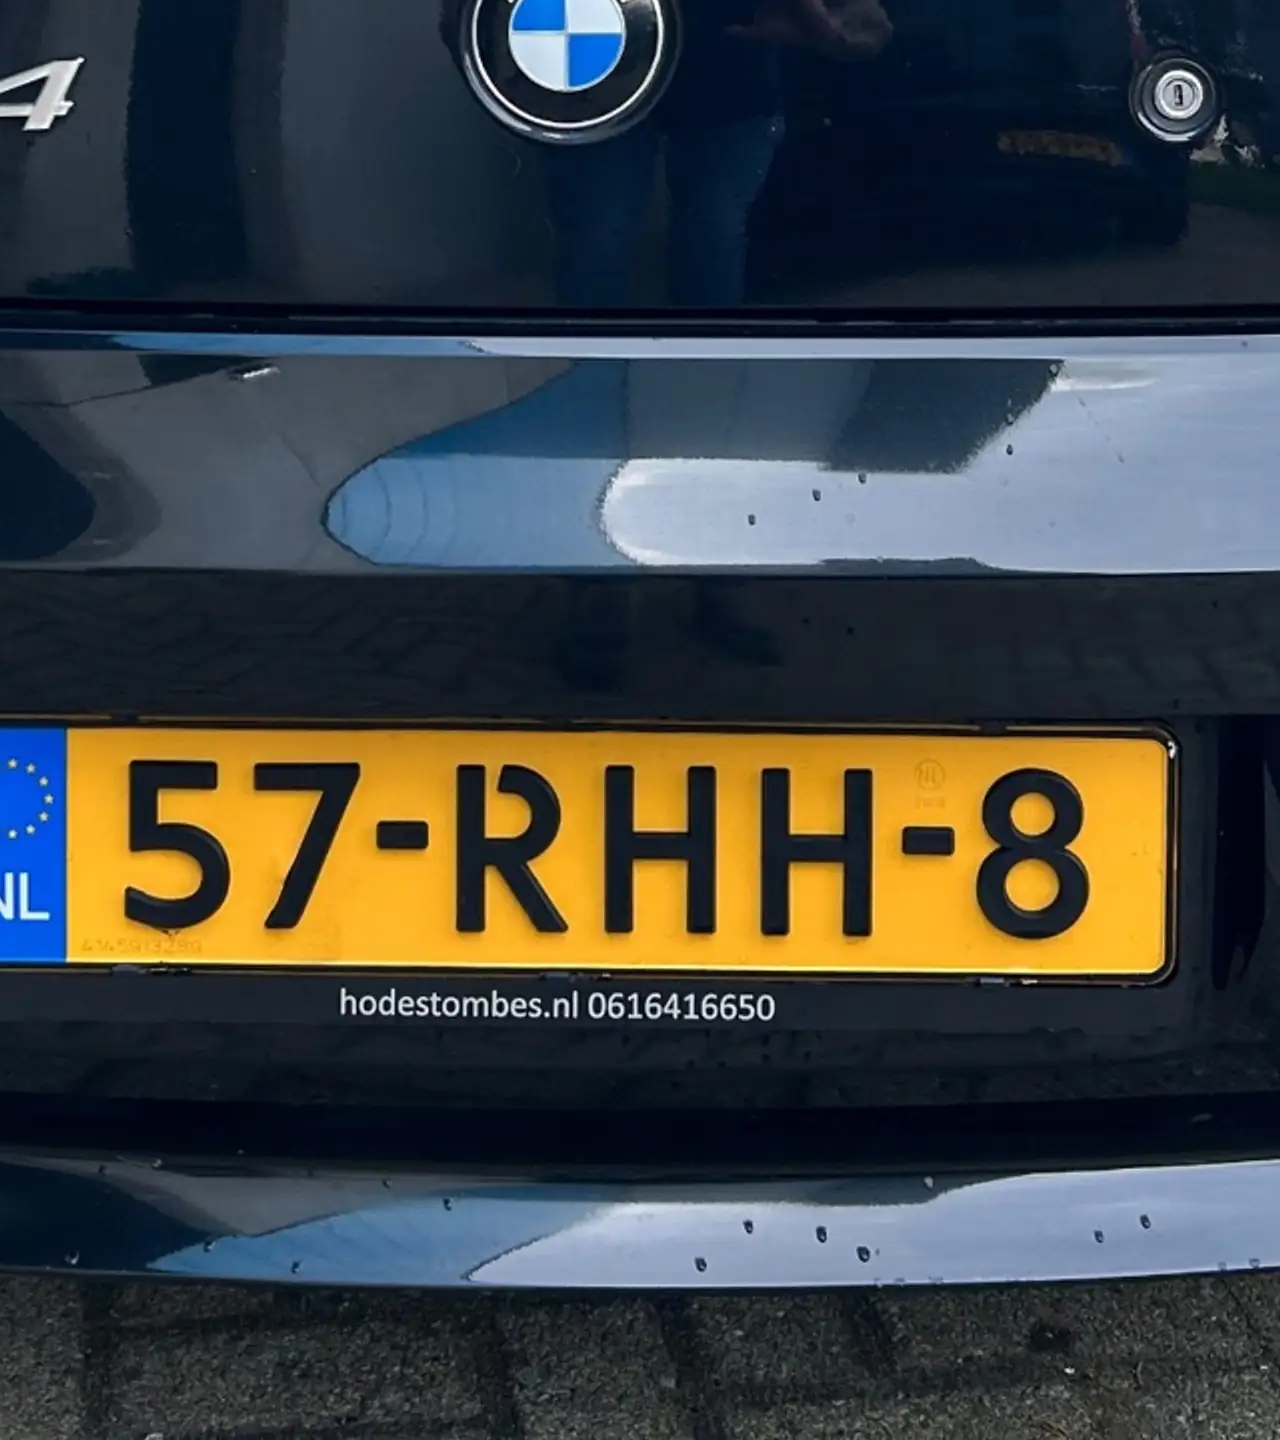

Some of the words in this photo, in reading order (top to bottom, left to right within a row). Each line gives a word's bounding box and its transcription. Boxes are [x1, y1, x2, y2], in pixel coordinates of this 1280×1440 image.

[124, 759, 1091, 940] 57-RHH-8
[338, 987, 579, 1020] hodestombes.nl
[586, 991, 777, 1022] 0616416650
